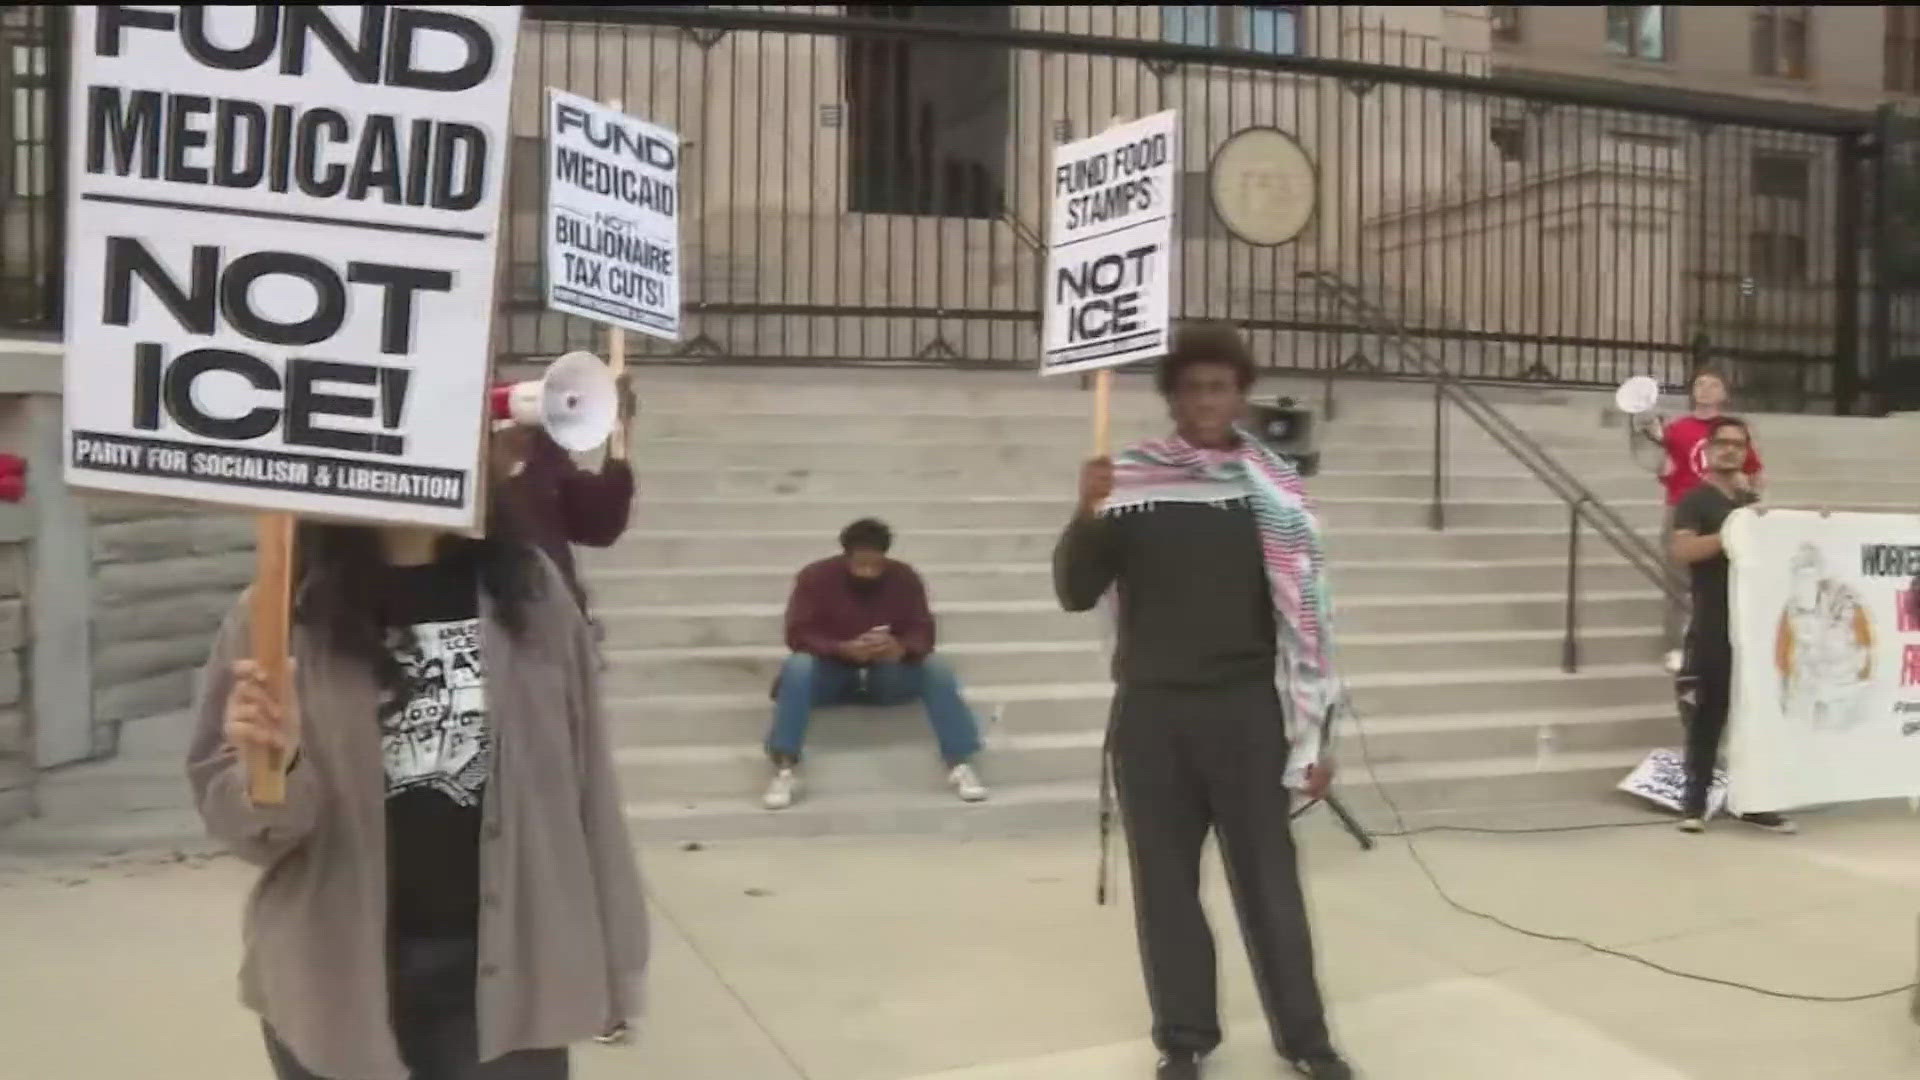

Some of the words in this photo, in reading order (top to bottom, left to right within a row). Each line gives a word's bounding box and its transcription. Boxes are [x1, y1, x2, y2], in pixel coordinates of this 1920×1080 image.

[95, 6, 494, 91] FUND
[86, 85, 488, 211] MEDICAID
[557, 103, 674, 171] FUND
[1056, 153, 1107, 198] FUND
[1113, 132, 1166, 180] FOOD
[557, 146, 674, 216] MEDICAID
[1066, 175, 1152, 231] STAMPS
[555, 215, 673, 277] BILLIONAIRE
[1057, 244, 1157, 305] NOT
[102, 235, 453, 355] NOT
[563, 252, 602, 289] TAX
[608, 266, 665, 309] CUTS!
[133, 343, 411, 456] ICE!
[75, 437, 141, 468] PARTY
[147, 445, 188, 473] FOR
[190, 451, 309, 485] SOCIALISM
[313, 465, 332, 487] &
[336, 465, 460, 500] LIBERATION
